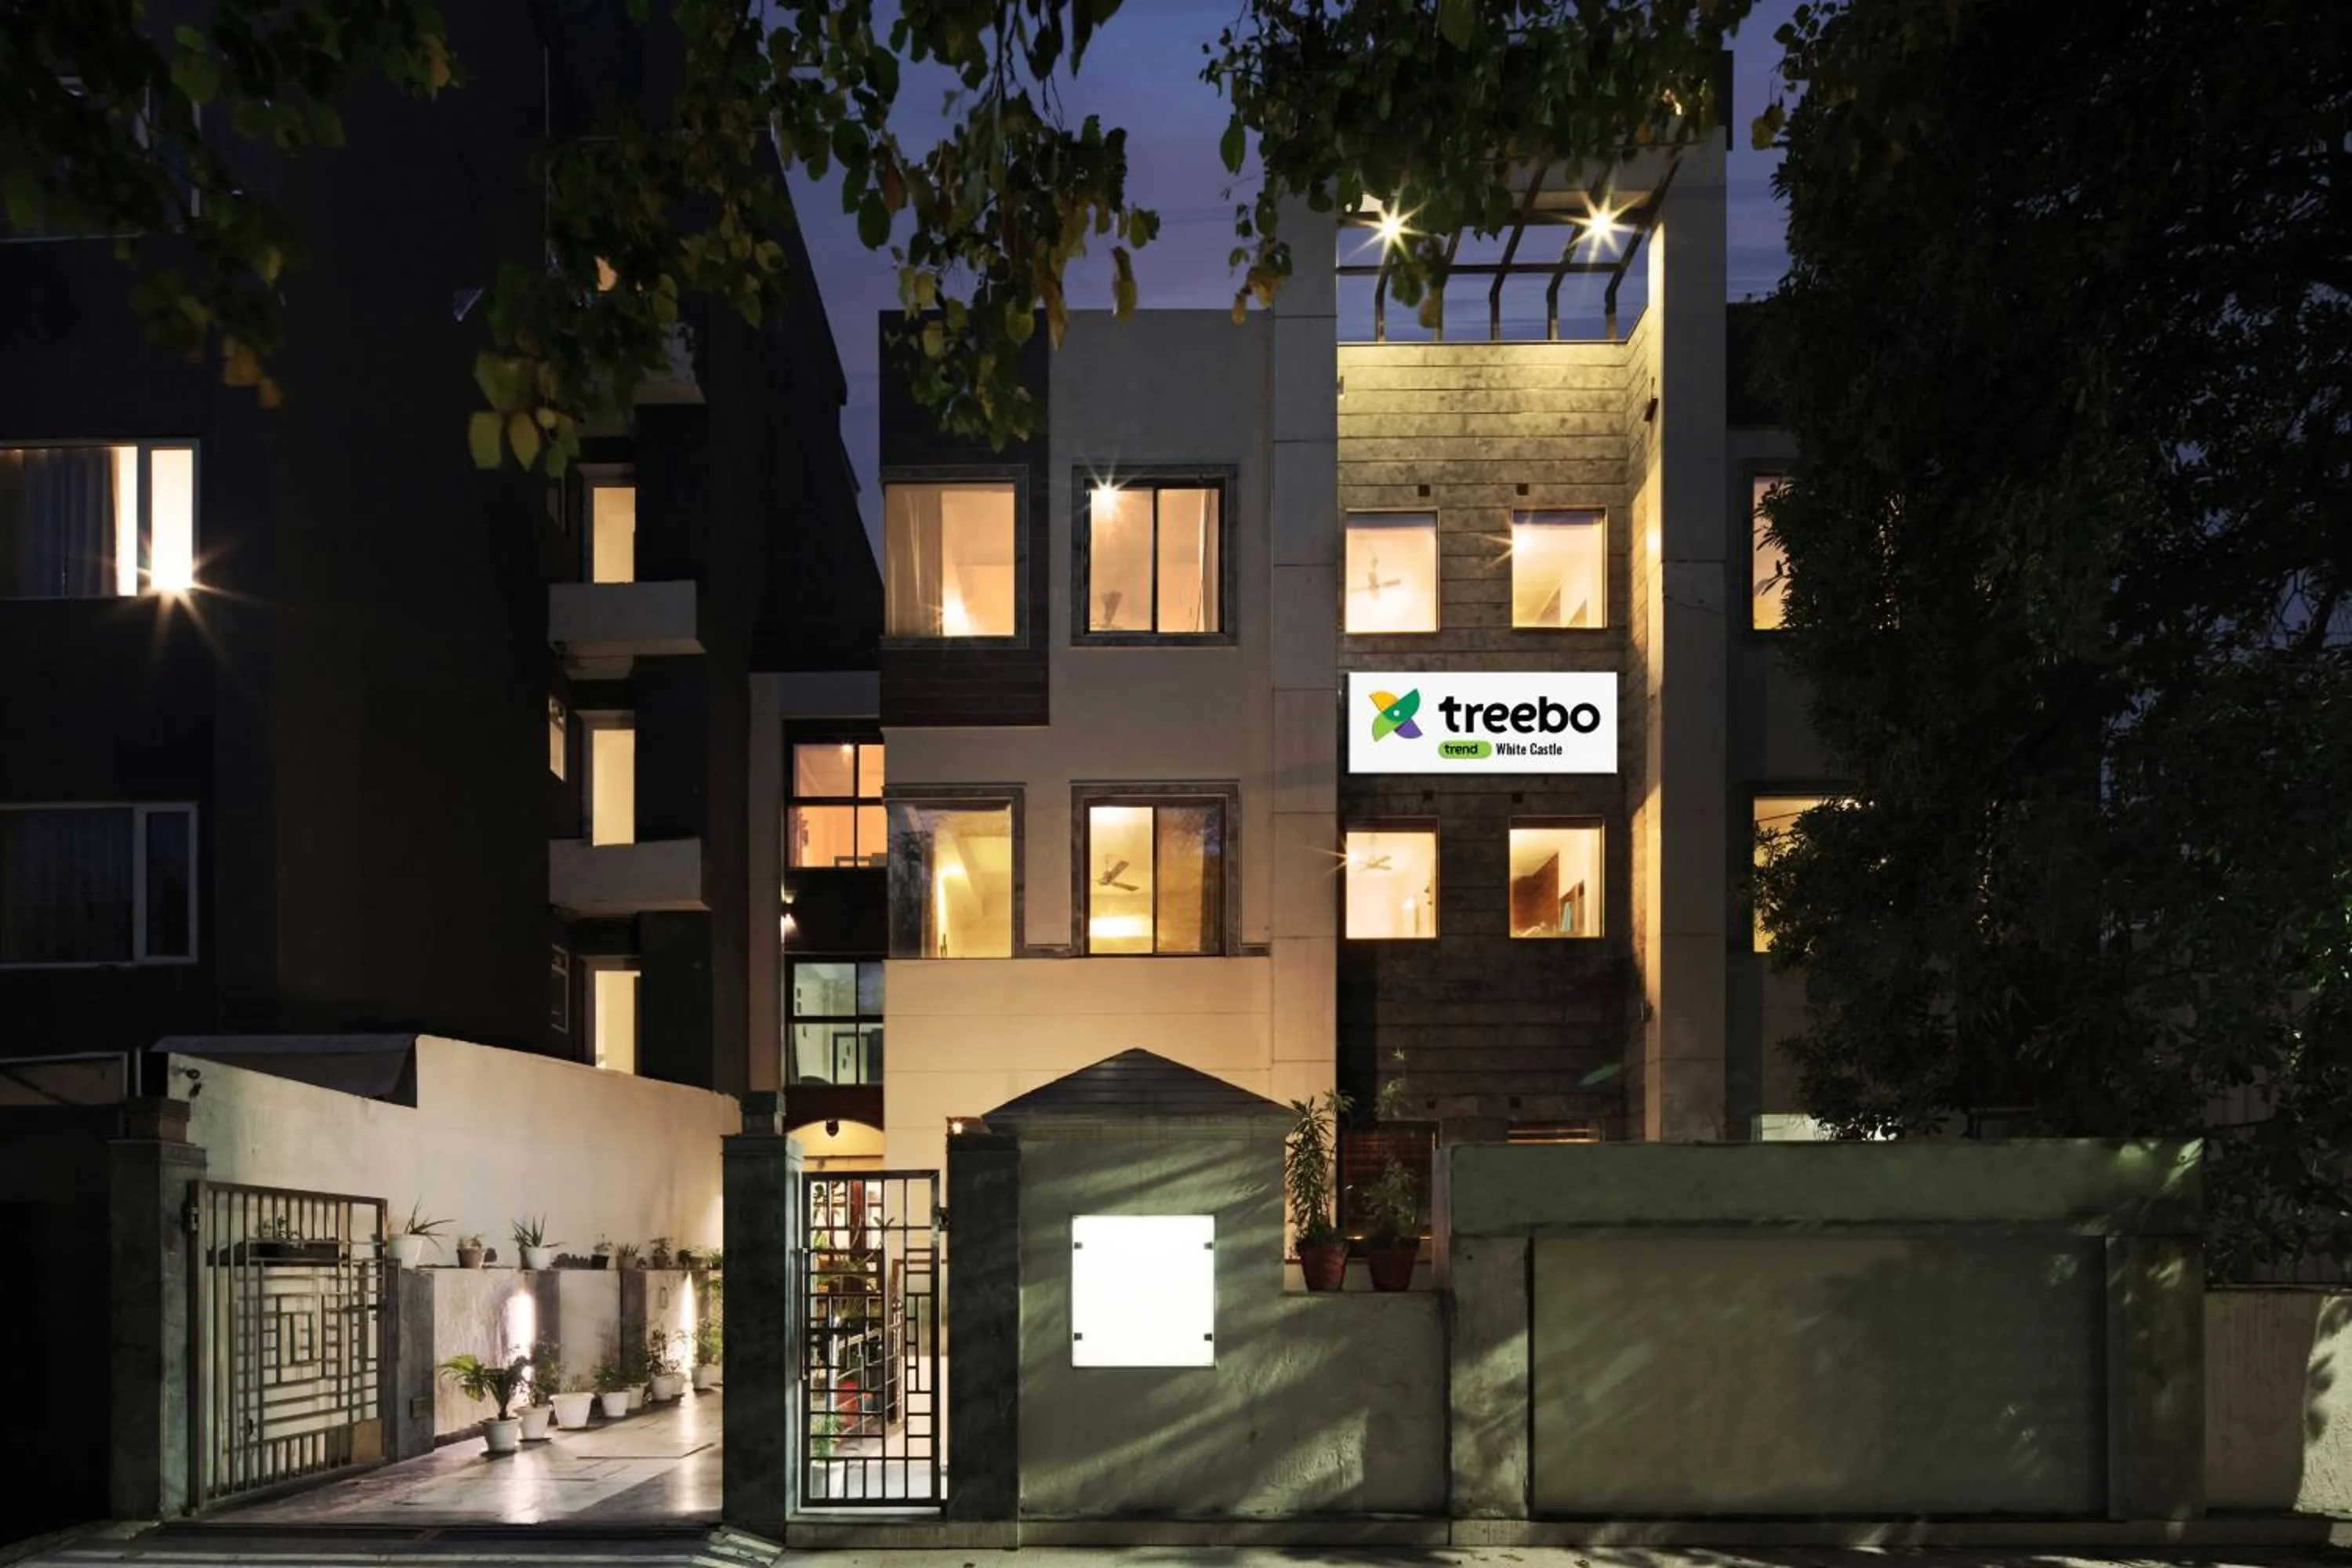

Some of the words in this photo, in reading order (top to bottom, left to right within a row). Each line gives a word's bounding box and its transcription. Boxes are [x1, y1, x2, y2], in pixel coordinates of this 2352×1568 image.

[1438, 695, 1601, 734] treebo
[1444, 743, 1478, 755] trend
[1495, 742, 1527, 756] White
[1530, 742, 1563, 756] Castle
